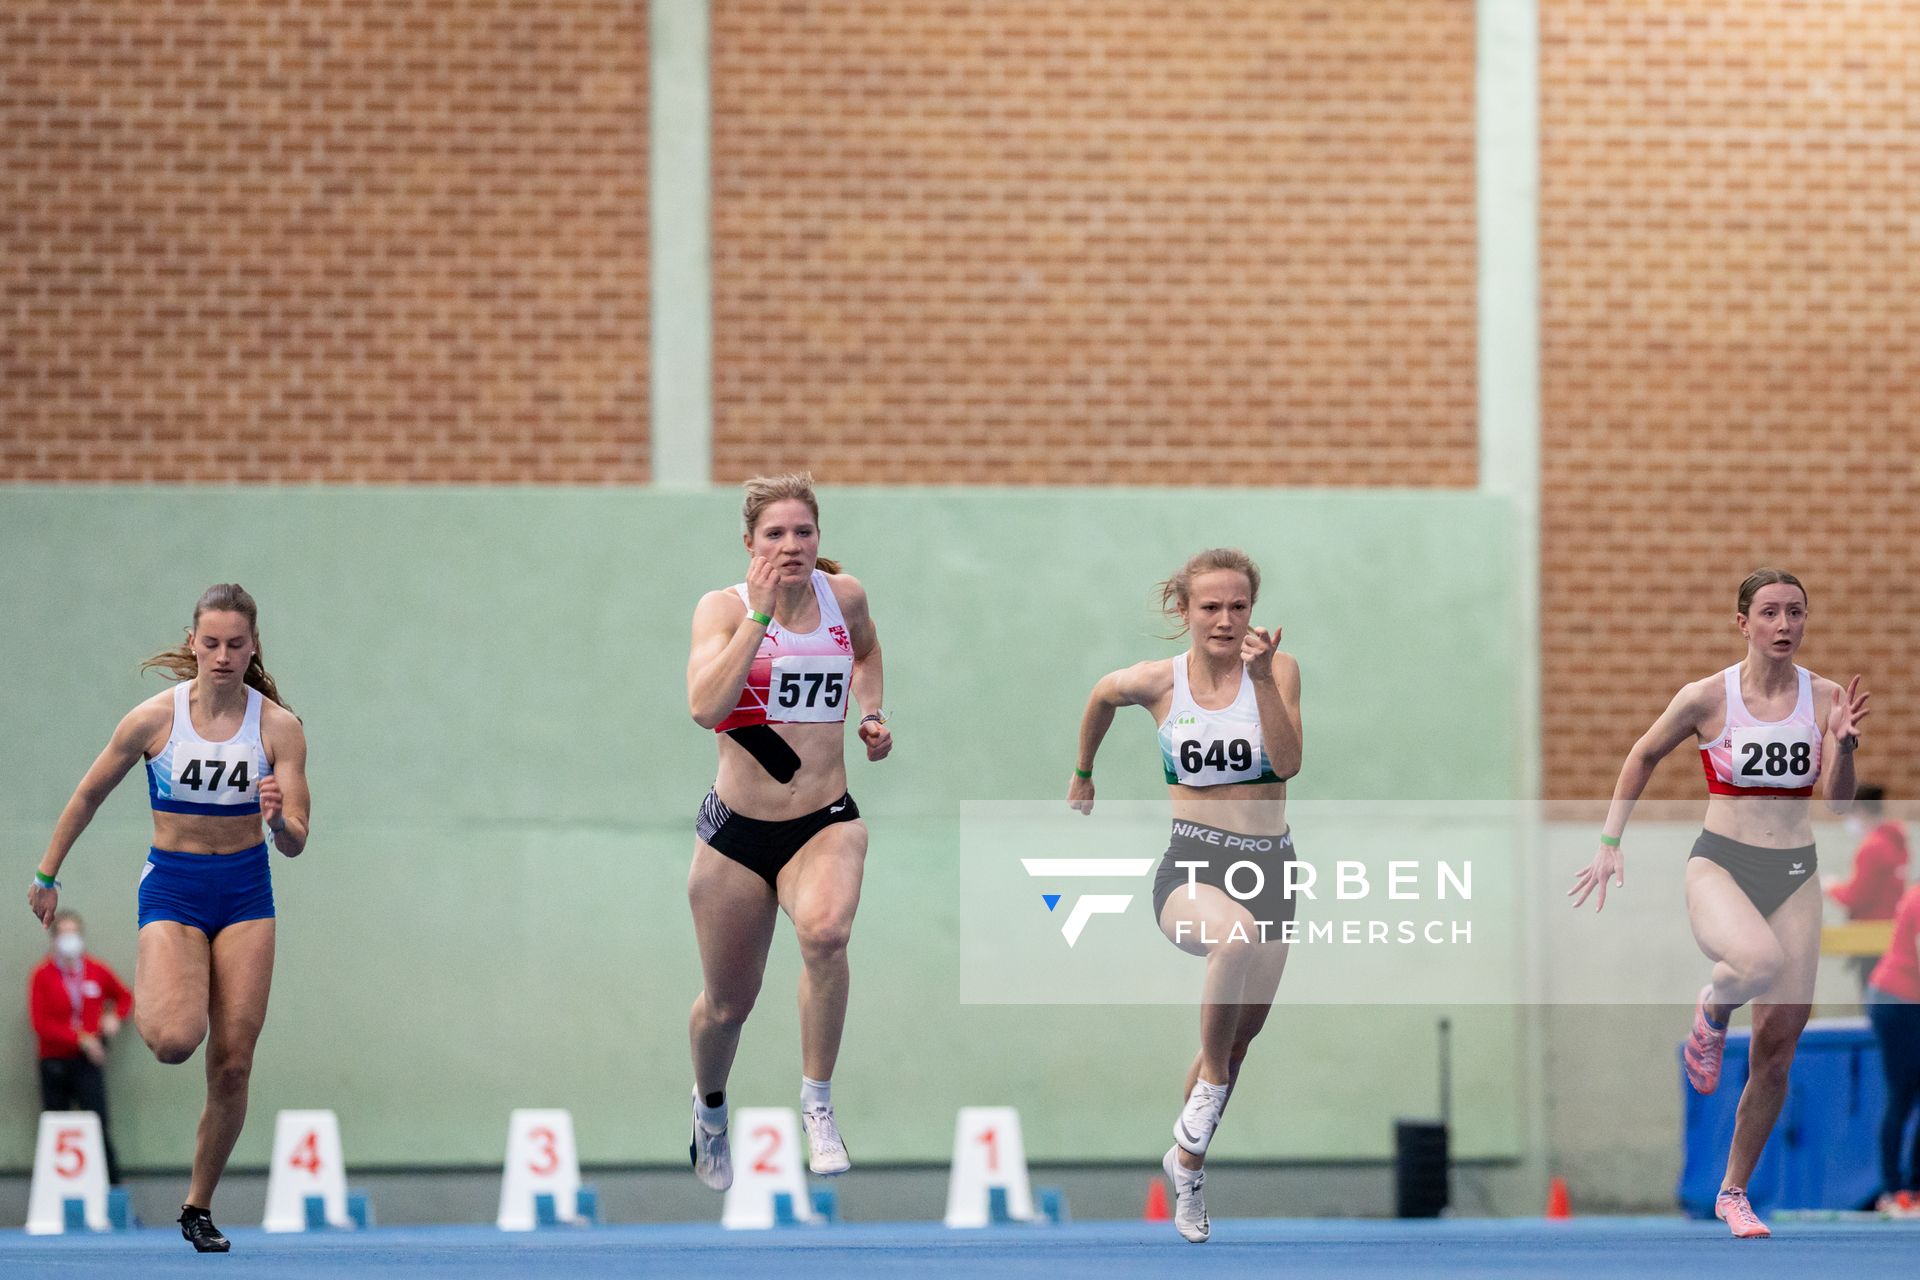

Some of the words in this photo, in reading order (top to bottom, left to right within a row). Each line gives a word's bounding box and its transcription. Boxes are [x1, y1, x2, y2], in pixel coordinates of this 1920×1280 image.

[778, 673, 844, 708] 575
[179, 759, 250, 792] 474
[1180, 739, 1252, 773] 649
[1741, 742, 1811, 776] 288
[1172, 822, 1223, 845] NIKE
[1224, 835, 1273, 852] PRO
[54, 1128, 86, 1178] 5
[289, 1130, 323, 1176] 4
[528, 1126, 559, 1177] 3
[750, 1124, 783, 1174] 2
[976, 1126, 999, 1173] 1
